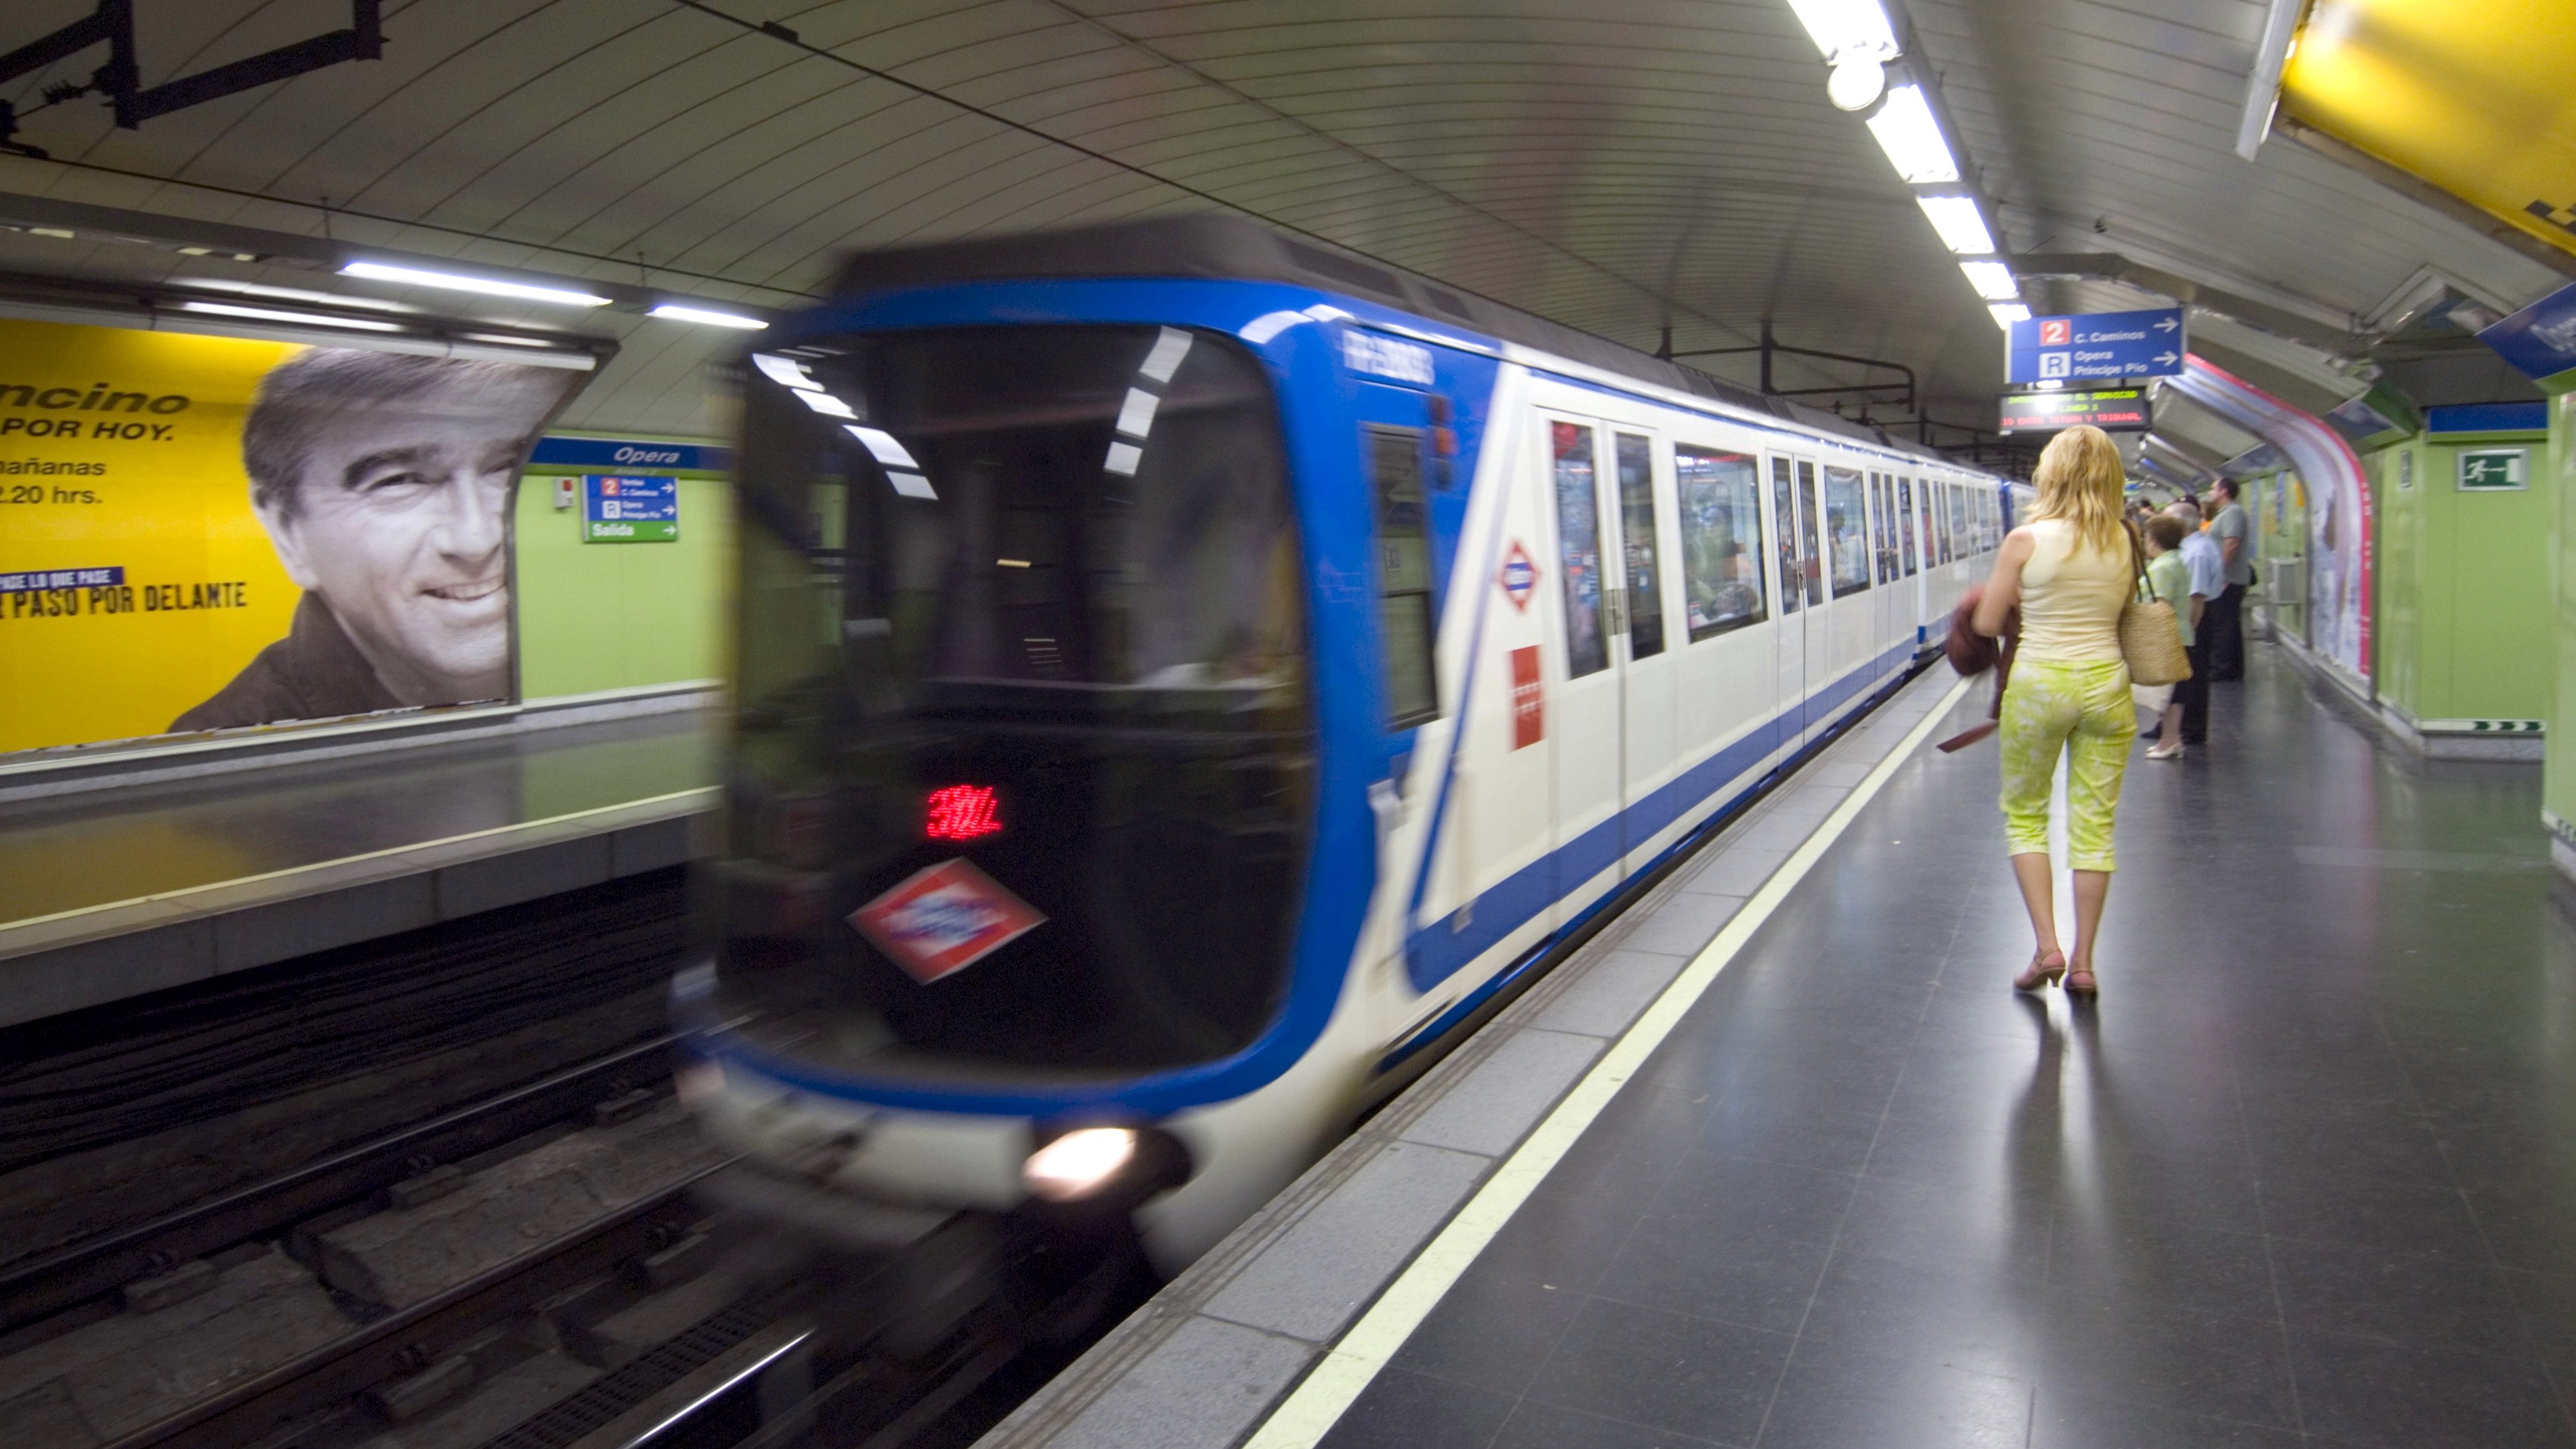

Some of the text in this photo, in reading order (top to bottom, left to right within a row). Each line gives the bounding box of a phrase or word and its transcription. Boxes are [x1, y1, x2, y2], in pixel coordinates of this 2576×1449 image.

[2046, 323, 2063, 343] 2
[2074, 331, 2146, 343] C. Caminos
[2074, 351, 2113, 362] Opera
[2048, 356, 2063, 375] R
[1, 419, 174, 441] POR HOY.
[614, 447, 680, 464] Opera
[52, 485, 102, 504] hrs.
[605, 480, 617, 494] 2
[592, 523, 635, 537] Salida
[28, 573, 48, 588] LO
[13, 591, 78, 618] PASO
[90, 586, 134, 615] POR
[144, 582, 246, 612] DELANTE
